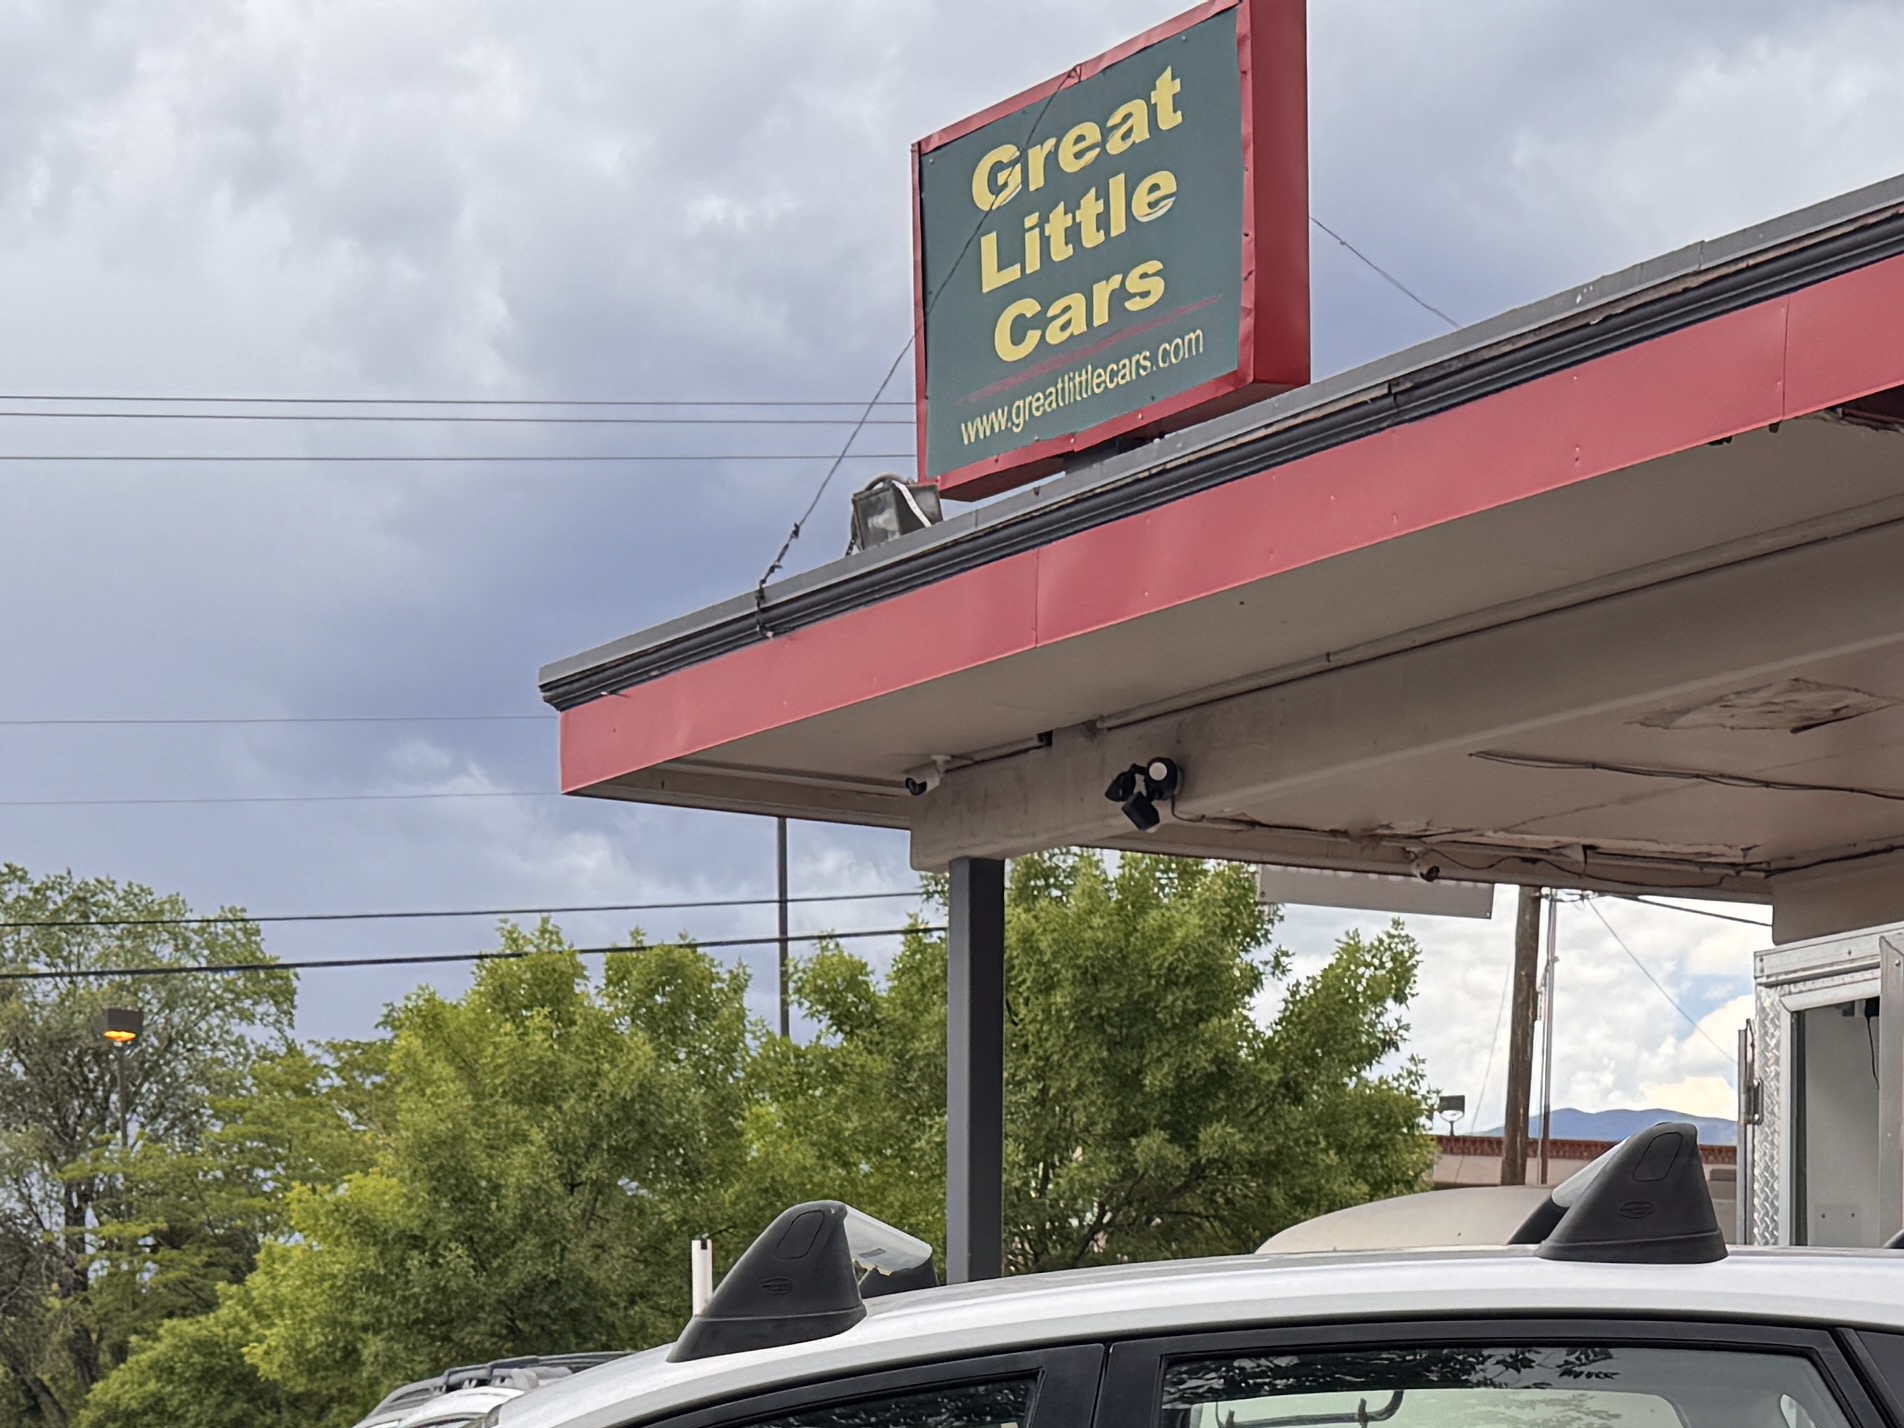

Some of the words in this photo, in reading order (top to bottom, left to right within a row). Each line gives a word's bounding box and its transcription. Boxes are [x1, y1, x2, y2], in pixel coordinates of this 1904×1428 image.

[971, 65, 1183, 212] Great
[980, 169, 1178, 294] Little
[993, 259, 1166, 363] Cars
[960, 326, 1204, 446] www.greatlittlecars.com
